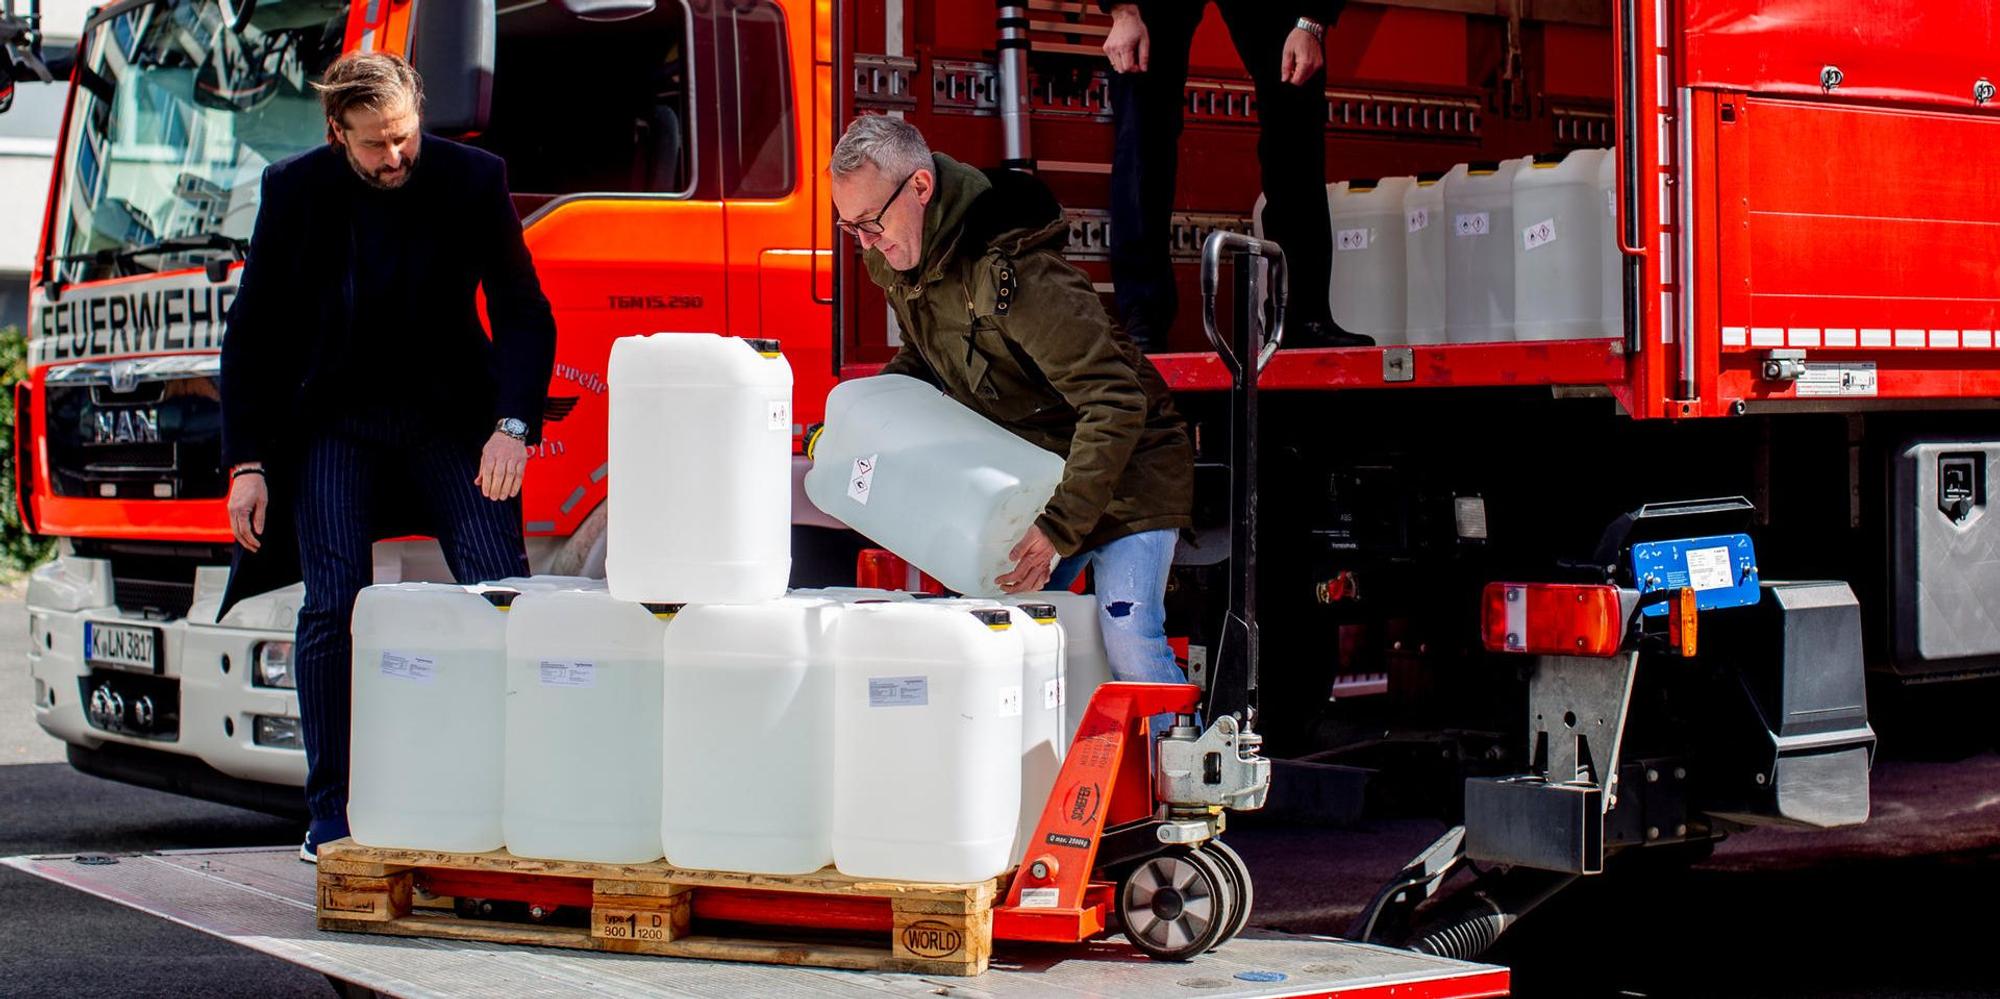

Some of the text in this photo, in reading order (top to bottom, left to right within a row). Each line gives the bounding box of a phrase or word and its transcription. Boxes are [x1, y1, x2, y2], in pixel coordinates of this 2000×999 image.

[94, 410, 159, 443] MAN
[93, 627, 152, 662] K LN 3817
[605, 913, 662, 938] type 1 D
[605, 926, 663, 939] 800 1200
[908, 929, 956, 951] WORLD
